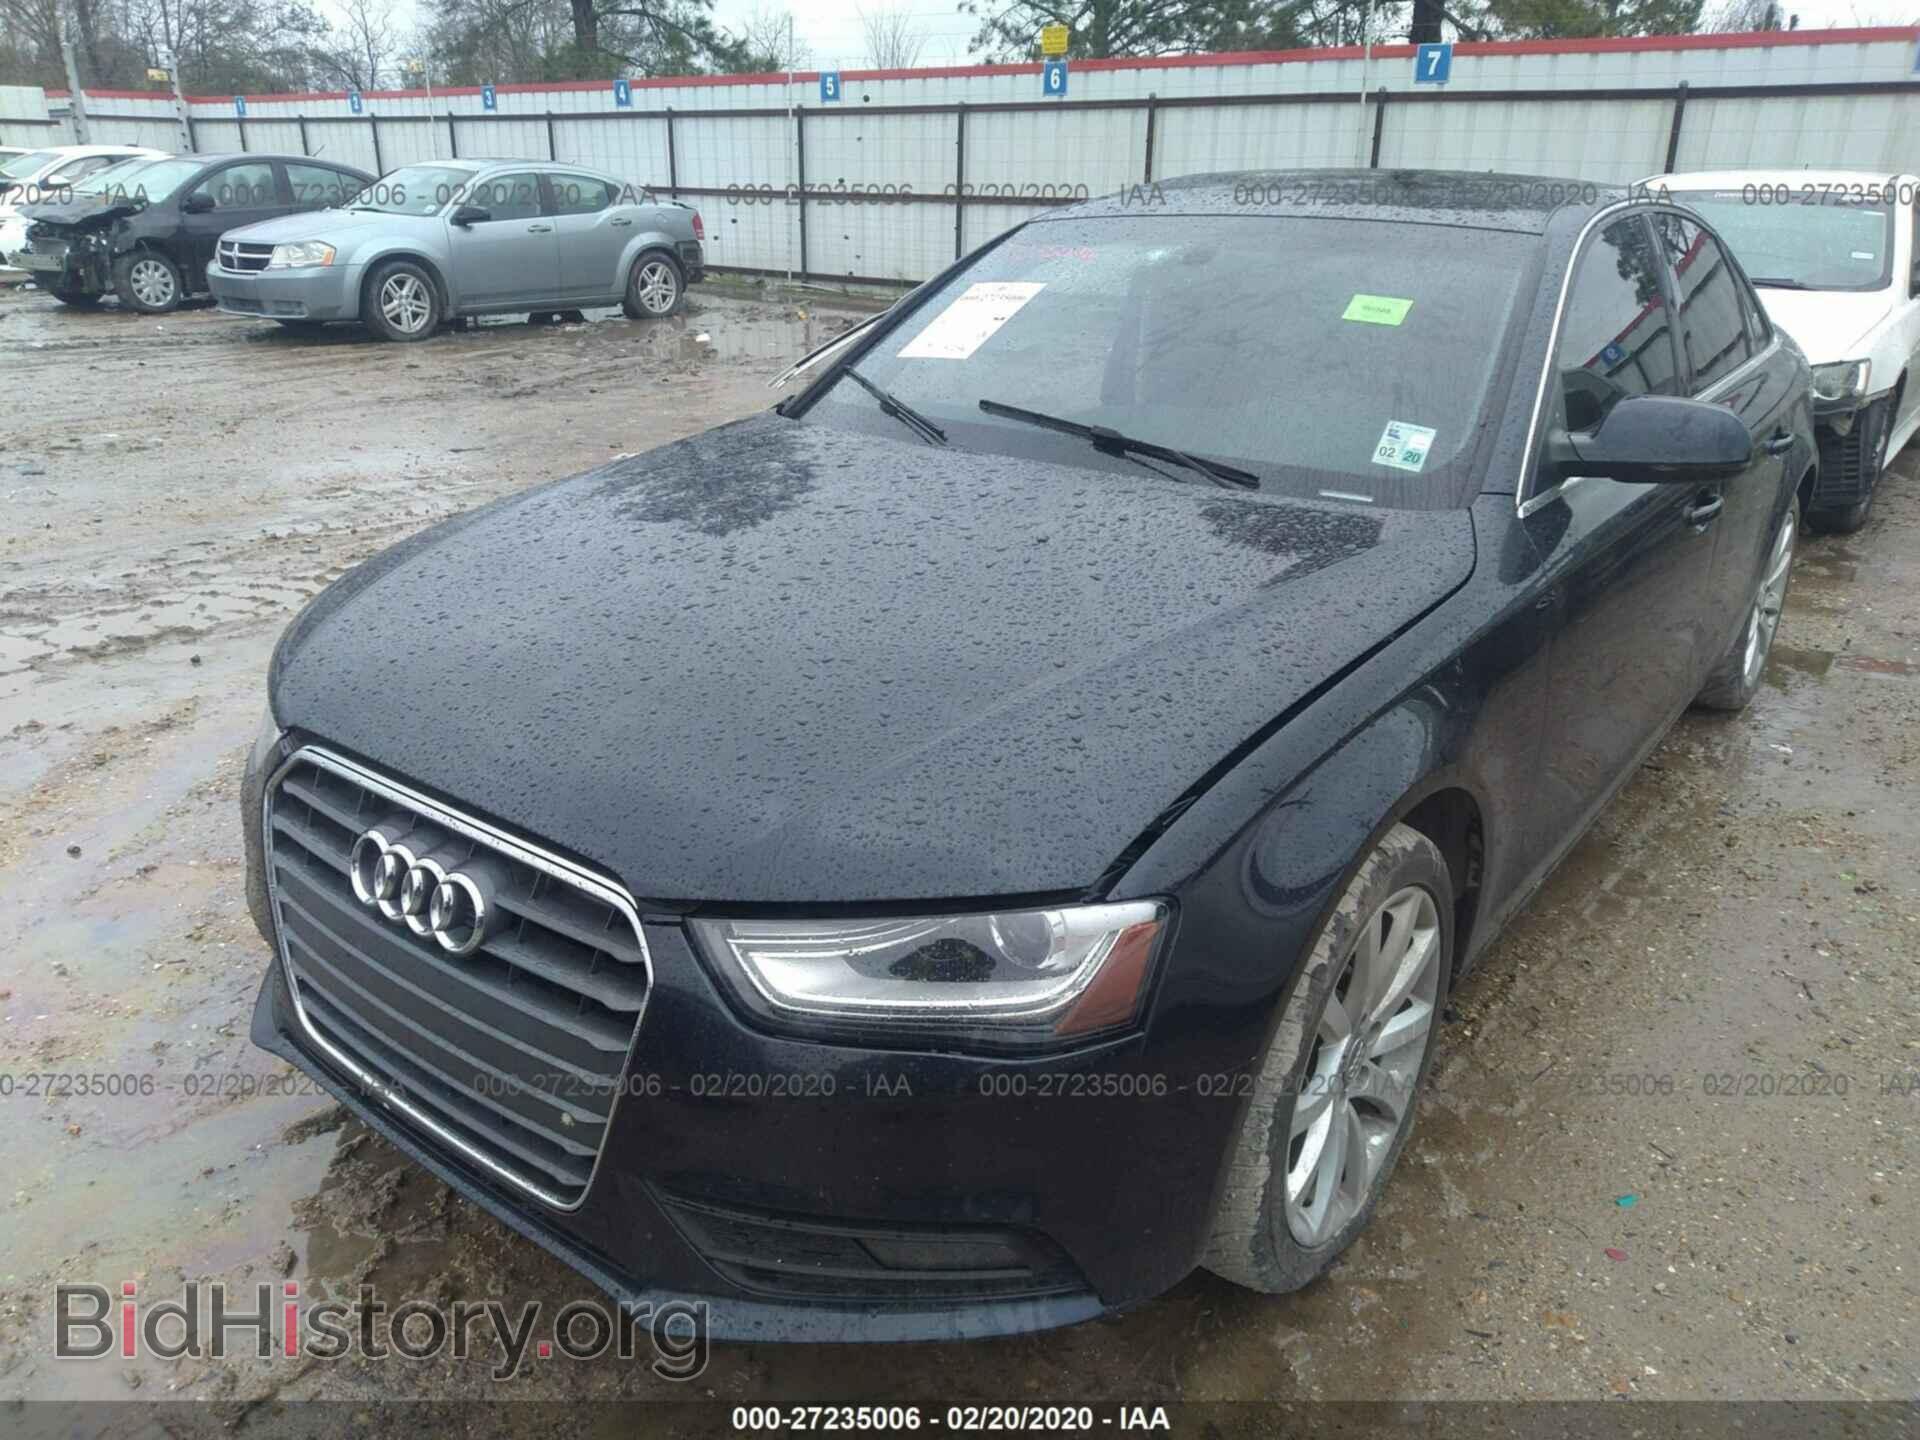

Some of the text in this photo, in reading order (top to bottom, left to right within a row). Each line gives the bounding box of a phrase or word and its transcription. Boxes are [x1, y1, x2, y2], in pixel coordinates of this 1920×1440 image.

[1427, 51, 1441, 76] 7
[826, 76, 835, 96] 5
[1050, 68, 1061, 90] 6
[618, 84, 626, 102] 4
[1379, 446, 1421, 464] 02 20
